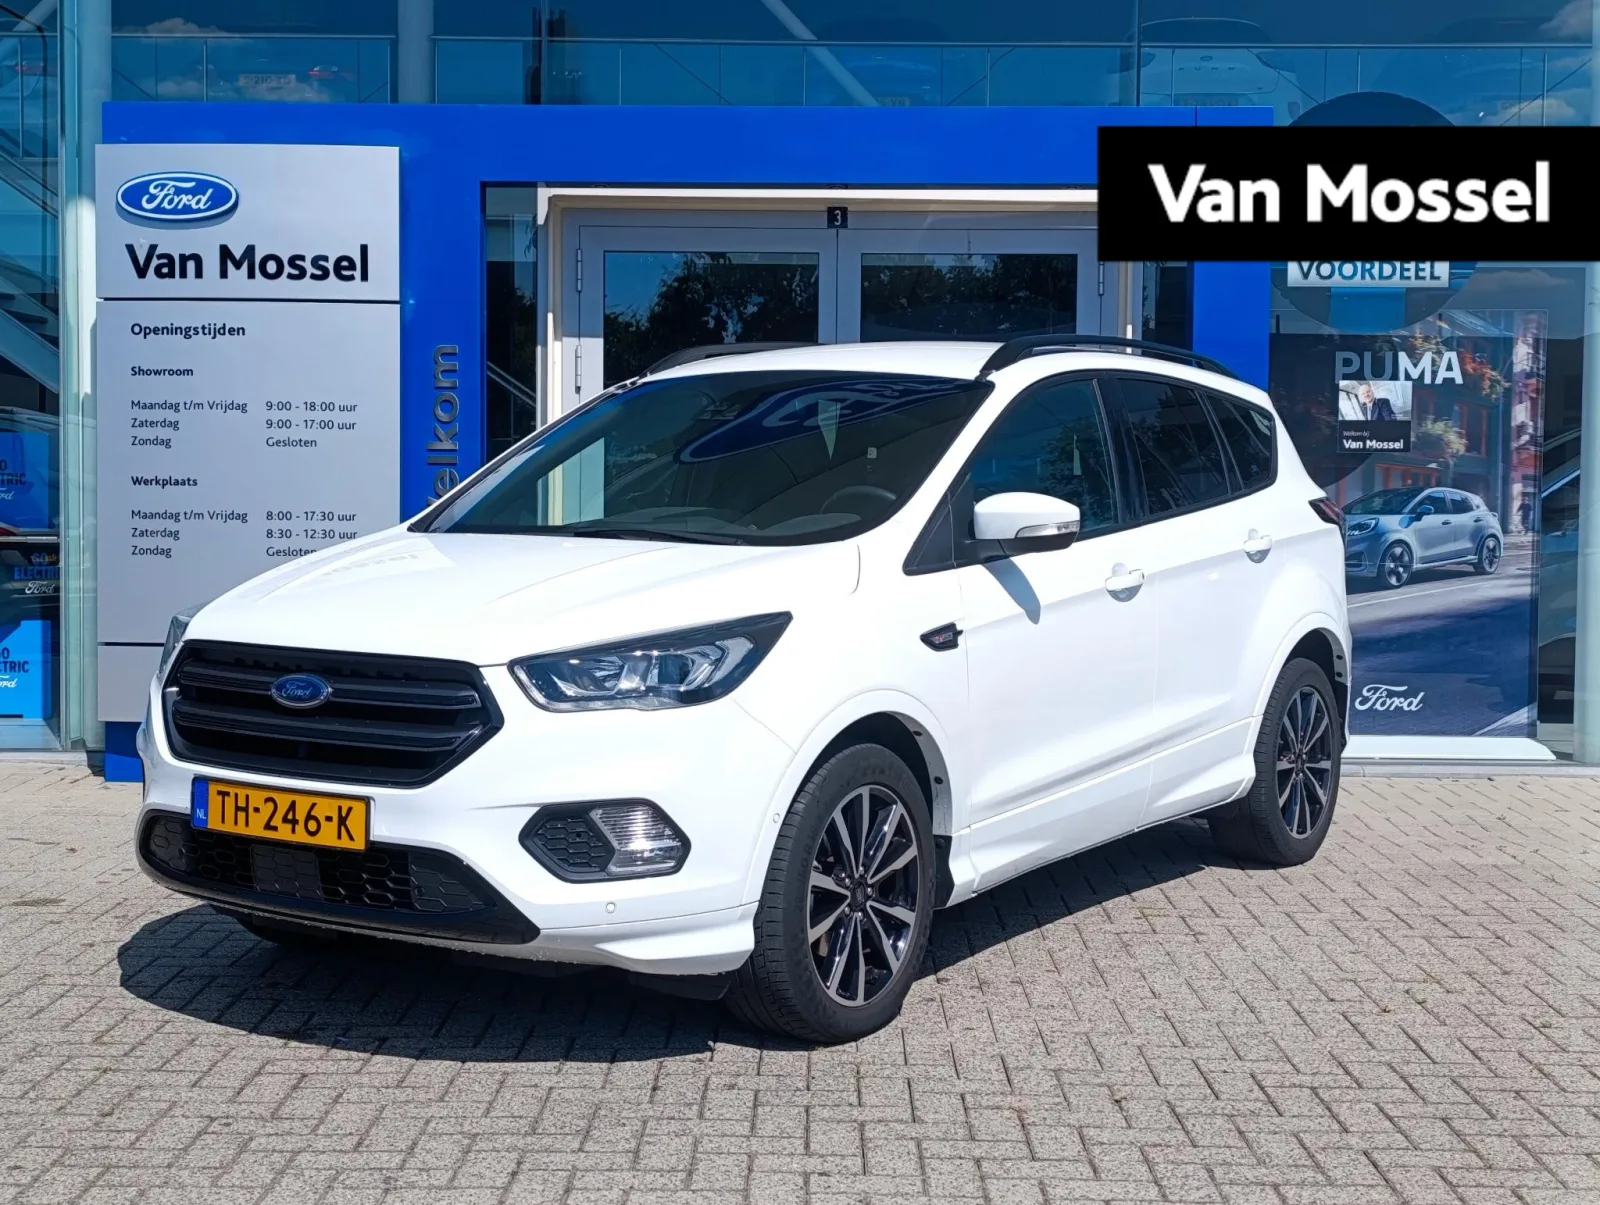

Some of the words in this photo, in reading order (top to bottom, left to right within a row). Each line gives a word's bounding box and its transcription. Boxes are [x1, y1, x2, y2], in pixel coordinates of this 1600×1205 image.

[141, 180, 214, 210] Ford
[834, 209, 841, 226] 3
[125, 244, 203, 280] Van
[218, 244, 369, 282] Mossel
[1299, 261, 1441, 281] VOORDEEL
[130, 322, 246, 340] Openingstijden
[130, 365, 194, 377] Showroom
[1335, 350, 1463, 385] PUMA
[130, 399, 181, 413] Maandag
[183, 399, 204, 411] t/m
[207, 400, 248, 414] Vrijdag
[265, 401, 292, 411] 9:00
[303, 401, 336, 412] 18:00
[338, 404, 358, 413] uur
[130, 417, 180, 431] Zaterdag
[265, 419, 292, 429] 9:00
[303, 419, 335, 430] 17:00
[337, 422, 357, 431] uur
[130, 435, 172, 449] Zondag
[265, 436, 318, 448] Gesloten
[1343, 439, 1364, 449] Van
[1366, 439, 1404, 449] Mossel
[130, 475, 198, 490] Werkplaats
[130, 509, 181, 523] Maandag
[183, 509, 205, 521] t/m
[207, 509, 248, 524] Vrijdag
[266, 510, 293, 521] 8:00
[303, 510, 335, 521] 17:30
[337, 513, 357, 522] uur
[131, 527, 180, 541] Zaterdag
[266, 528, 292, 539] 8:30
[303, 528, 335, 540] 12:30
[338, 531, 358, 540] uur
[131, 545, 172, 559] Zondag
[14, 566, 60, 580] ELECTRI
[25, 580, 55, 594] Ford
[0, 660, 30, 673] TRIC
[281, 680, 314, 697] Ford
[1355, 684, 1425, 712] Ford
[196, 808, 207, 819] NL
[216, 789, 356, 842] TH-246-K
